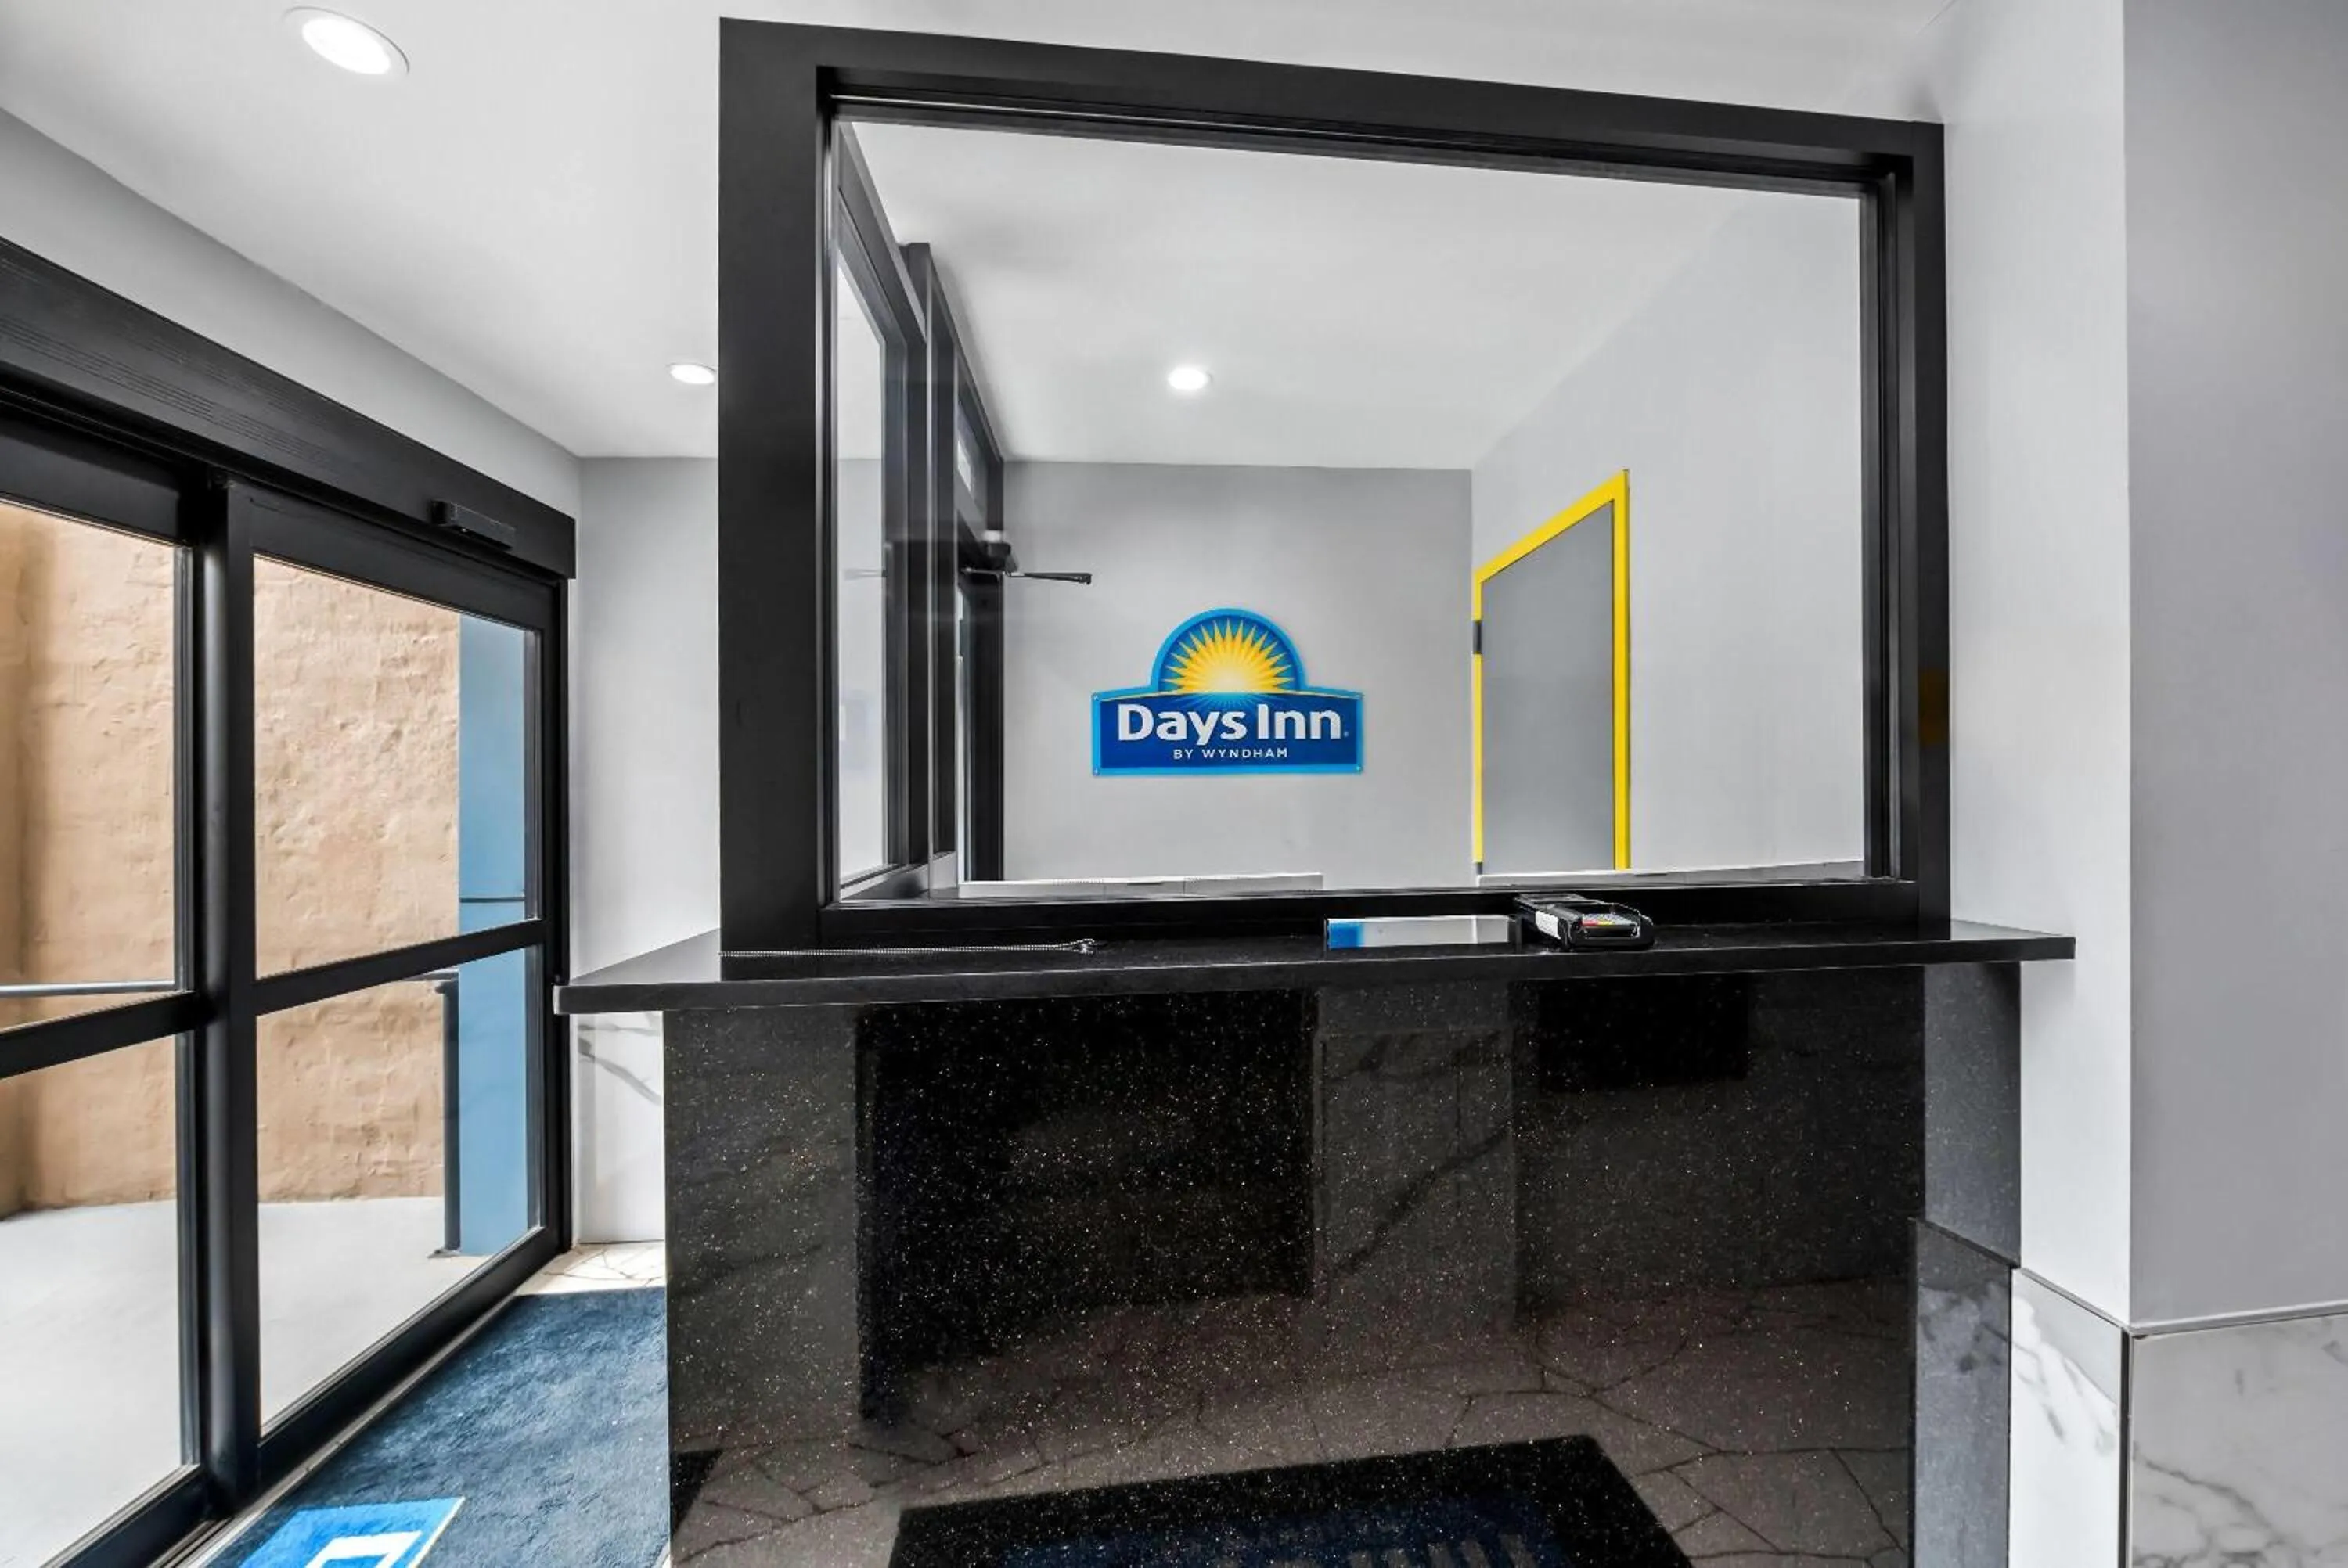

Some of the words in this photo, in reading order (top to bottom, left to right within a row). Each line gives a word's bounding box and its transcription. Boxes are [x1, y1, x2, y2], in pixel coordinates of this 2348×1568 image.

[1118, 704, 1248, 745] Days
[1257, 704, 1341, 739] Inn
[1173, 749, 1194, 759] BY
[1202, 748, 1287, 758] WYNDHAM
